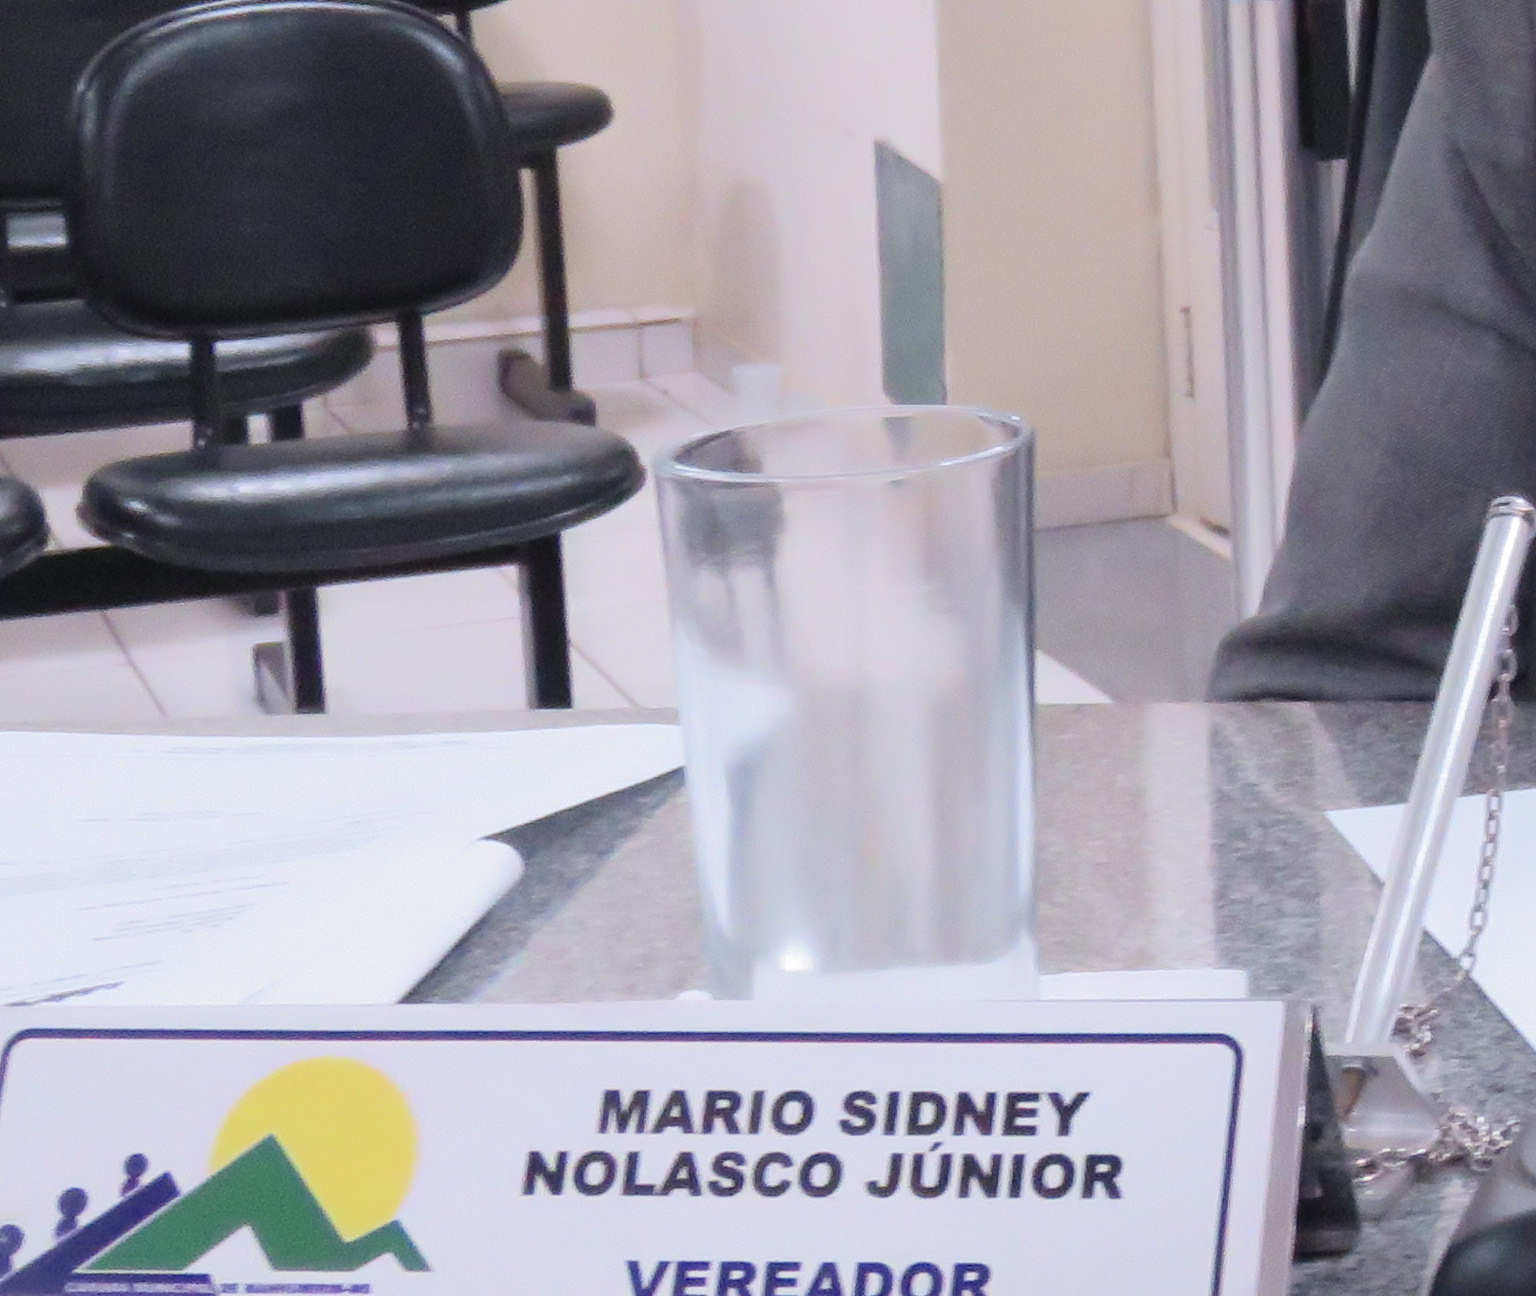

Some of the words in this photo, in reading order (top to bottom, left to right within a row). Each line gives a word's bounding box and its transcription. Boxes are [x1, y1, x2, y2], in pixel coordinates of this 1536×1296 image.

[598, 1090, 816, 1135] MARIO
[837, 1091, 1093, 1137] SIDNEY
[521, 1151, 844, 1198] NOLASCO
[865, 1141, 1125, 1201] JÚNIOR
[624, 1260, 992, 1296] VEREADOR
